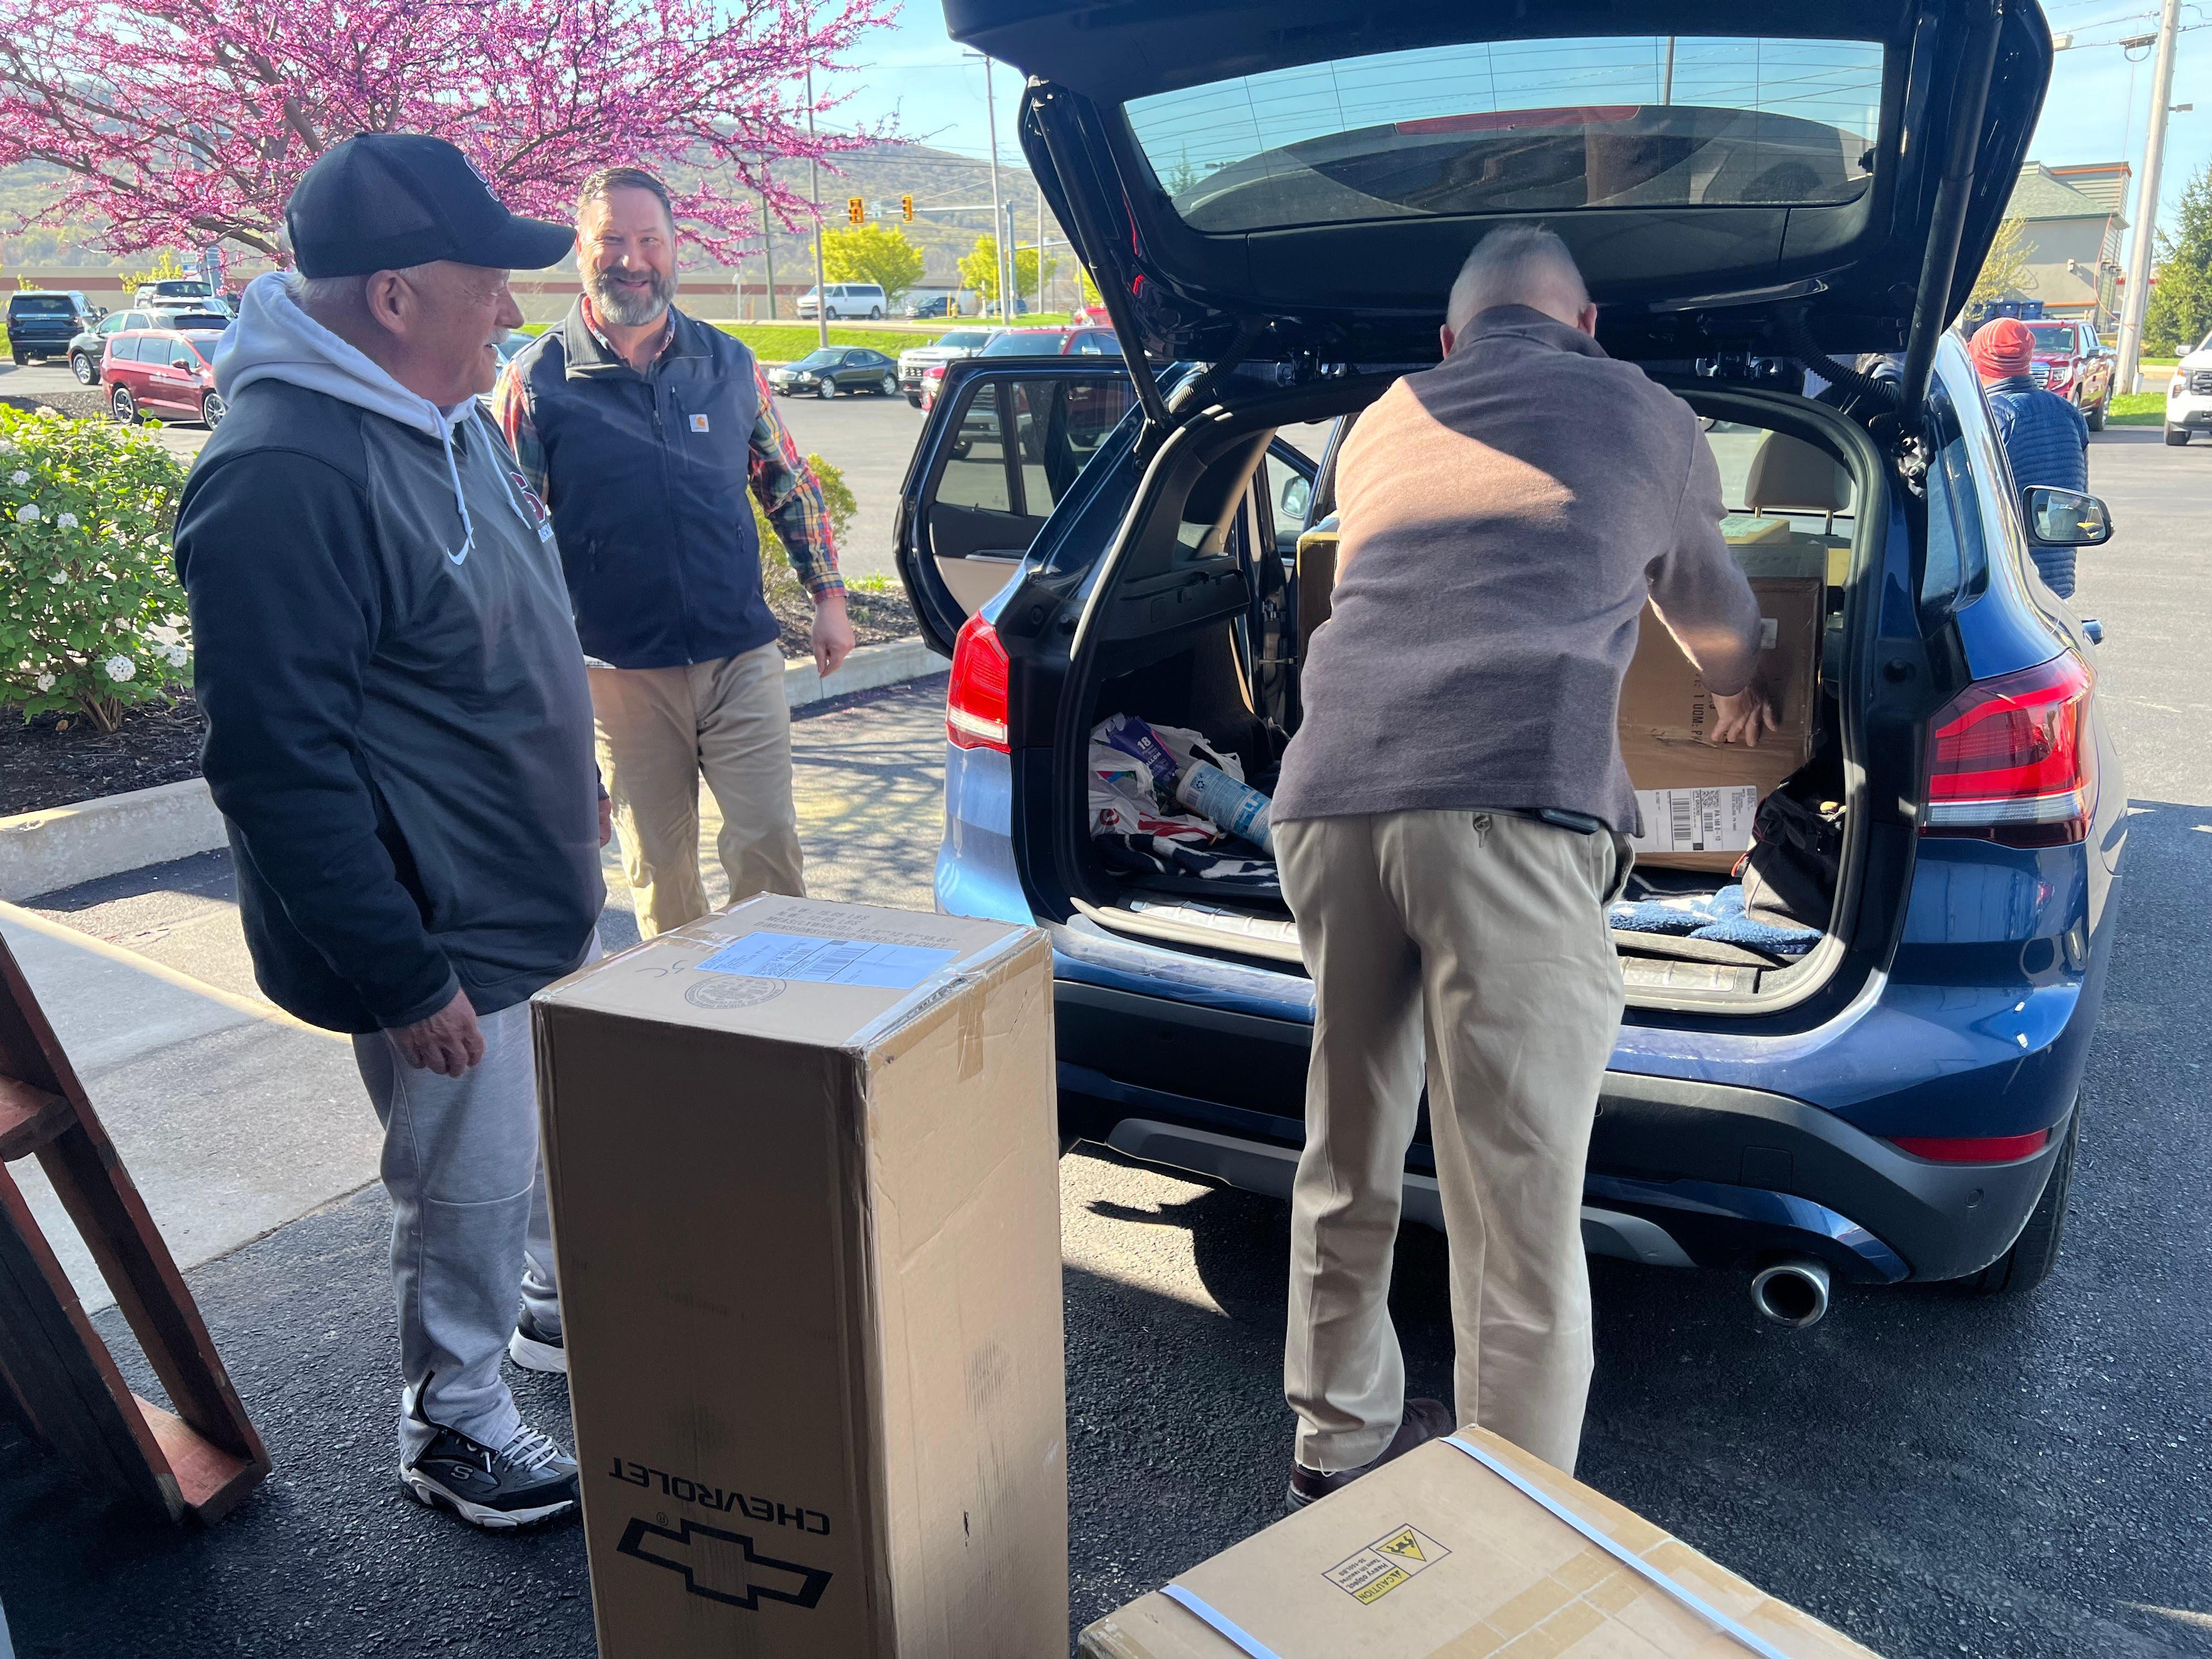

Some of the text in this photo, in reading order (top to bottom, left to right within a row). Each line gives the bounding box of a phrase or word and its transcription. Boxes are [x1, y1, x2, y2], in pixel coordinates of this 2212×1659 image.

[1137, 736, 1152, 751] 18
[1146, 752, 1161, 768] ALLON
[608, 1457, 830, 1536] CHEVROLET
[1367, 1562, 1389, 1576] Heavy
[1358, 1576, 1395, 1600] CAUTION
